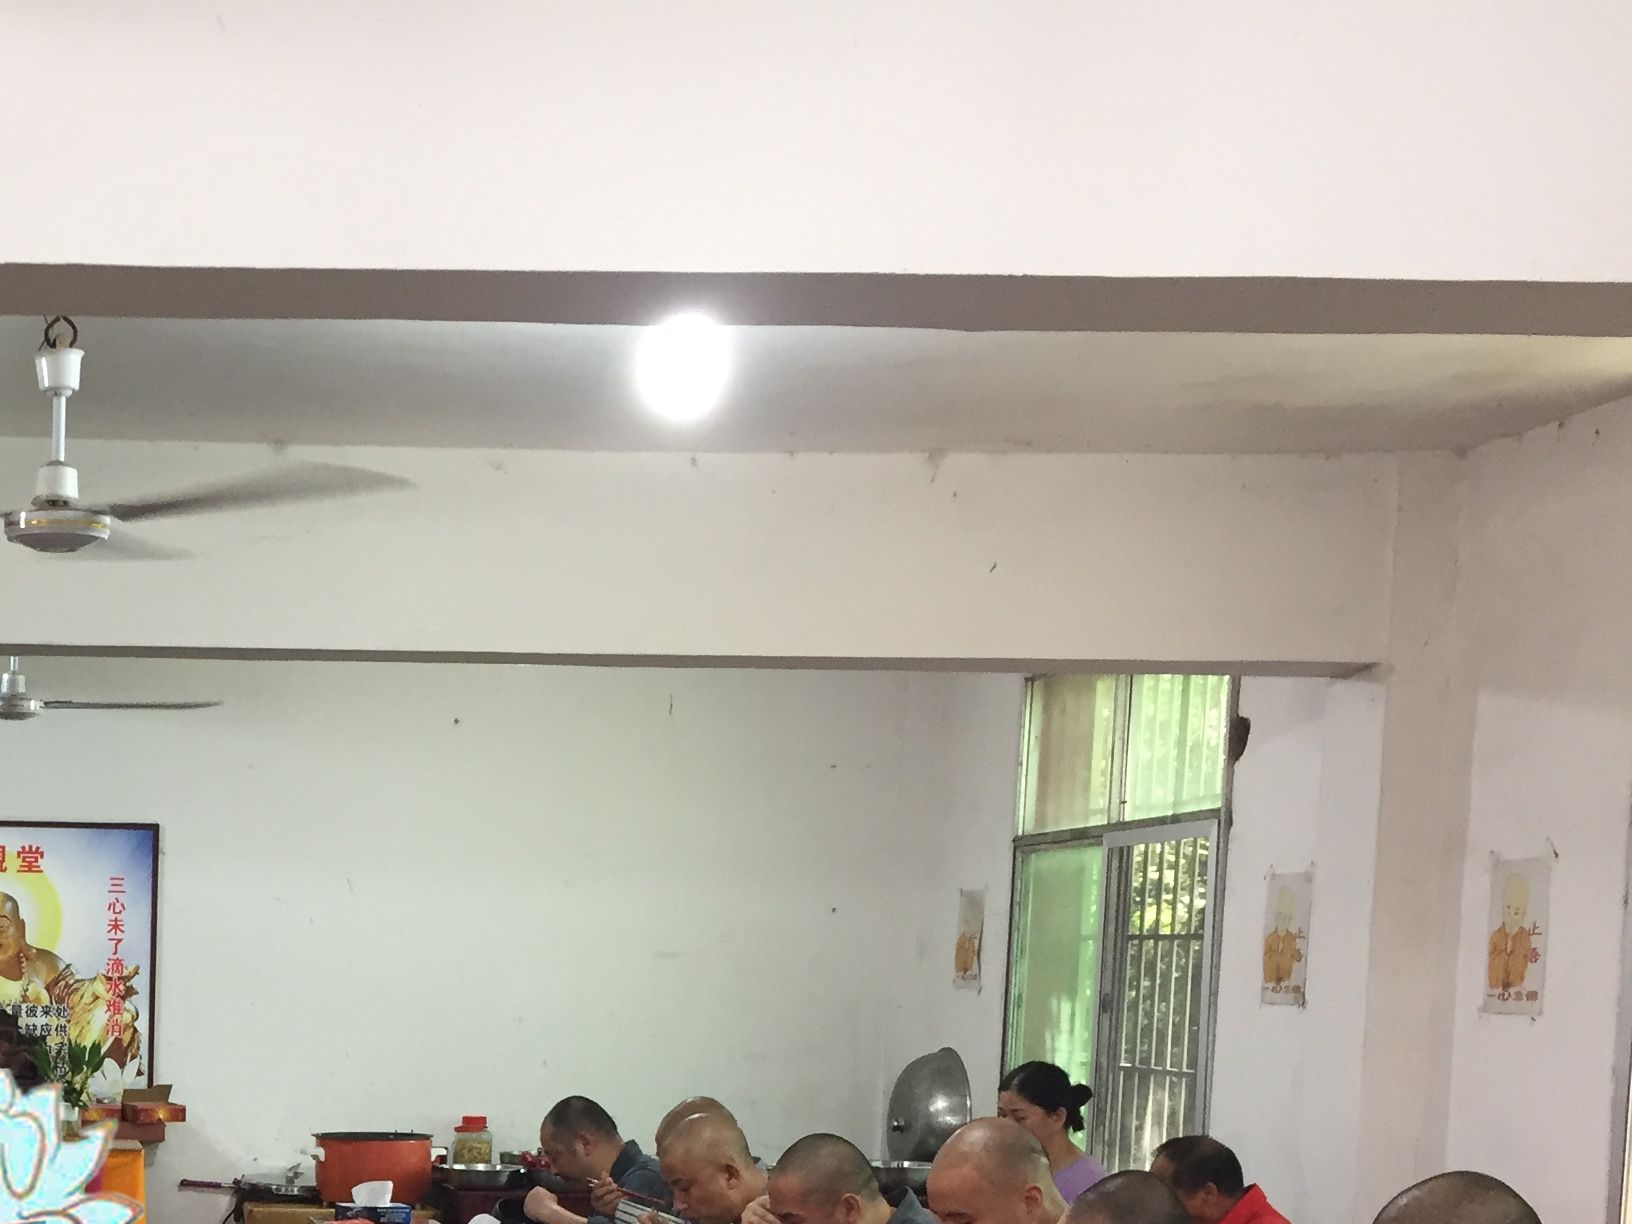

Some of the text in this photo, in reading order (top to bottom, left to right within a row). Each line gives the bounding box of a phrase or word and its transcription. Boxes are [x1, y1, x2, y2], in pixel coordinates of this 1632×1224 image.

[105, 876, 127, 1038] 三心未了滴水难消
